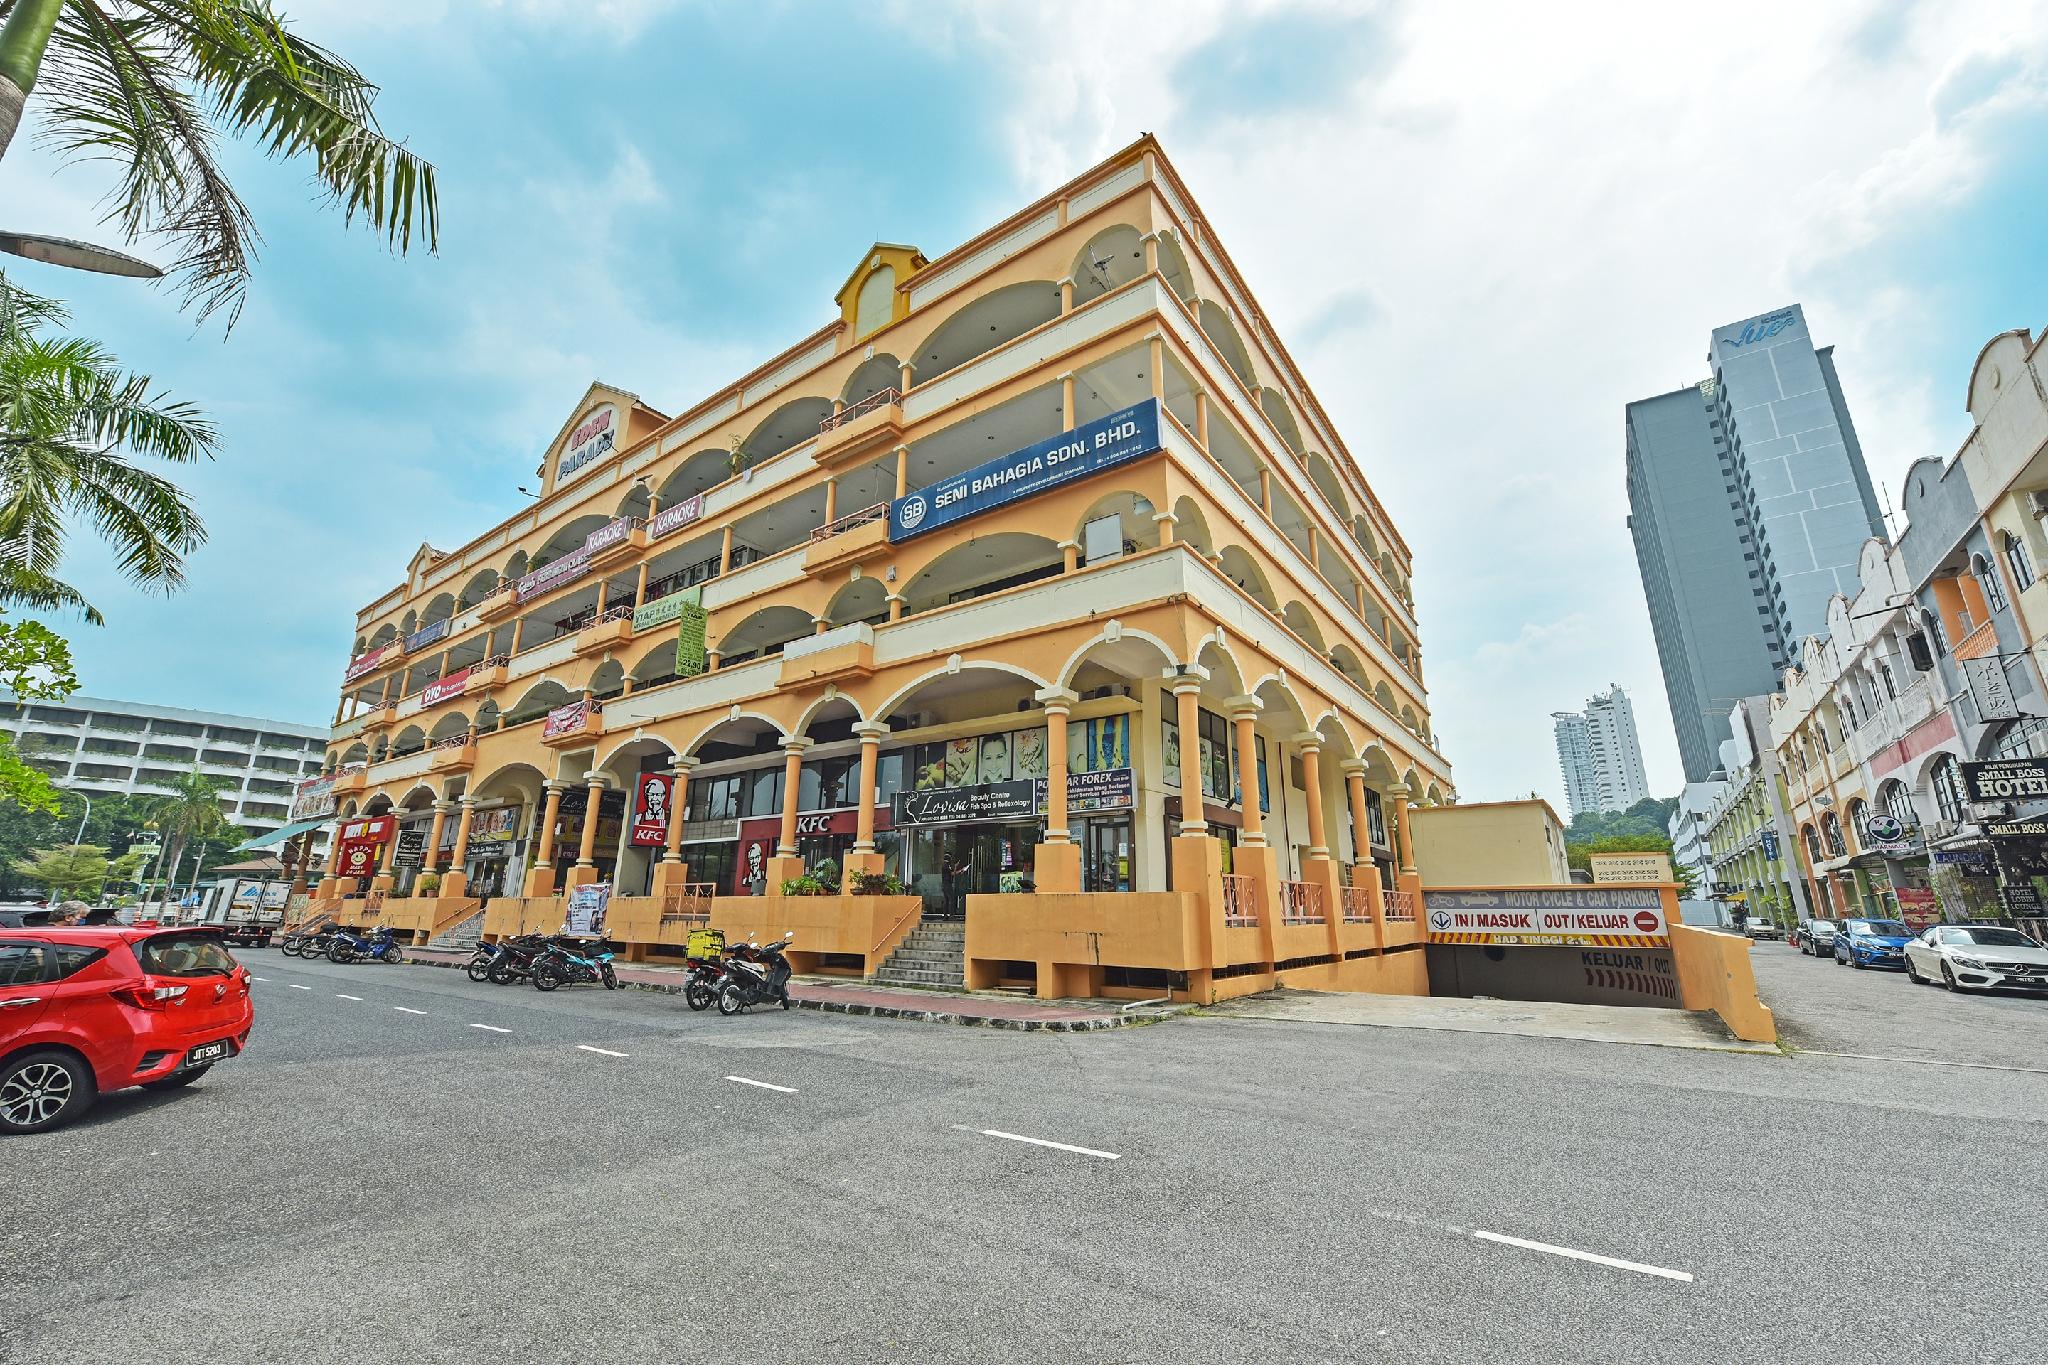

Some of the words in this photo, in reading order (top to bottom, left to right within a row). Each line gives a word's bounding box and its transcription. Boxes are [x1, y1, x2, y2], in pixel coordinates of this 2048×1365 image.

[571, 409, 612, 451] EDEN
[935, 489, 968, 509] SENI
[972, 456, 1043, 494] BAHAGIA
[1046, 440, 1090, 467] SDN.
[1095, 421, 1142, 449] BHD.
[656, 501, 697, 533] KARAOKE
[903, 501, 923, 521] SB
[588, 523, 623, 551] KARAOKE
[1081, 773, 1112, 785] FOREX
[1977, 770, 2015, 780] SMALL
[2015, 768, 2046, 778] BOSS
[970, 794, 989, 802] Beauty
[919, 796, 969, 815] Lovisa
[981, 802, 991, 810] Spa
[796, 816, 830, 833] KFC
[1988, 824, 2020, 835] SMALL
[2020, 823, 2046, 834] BOSS
[636, 829, 663, 841] KFC
[348, 845, 372, 854] HAPPY
[1936, 853, 1982, 862] LAUNDRY
[1504, 891, 1540, 907] MOTOR
[1541, 891, 1574, 907] CYCLE
[1577, 891, 1584, 907] &
[1587, 891, 1609, 906] CAR
[1610, 890, 1659, 907] PARKING
[1493, 935, 1518, 943] HAD
[1521, 935, 1563, 944] TINGGI
[1581, 951, 1644, 971] KELUAR
[1654, 958, 1671, 975] OUT
[205, 1044, 221, 1056] 5203
